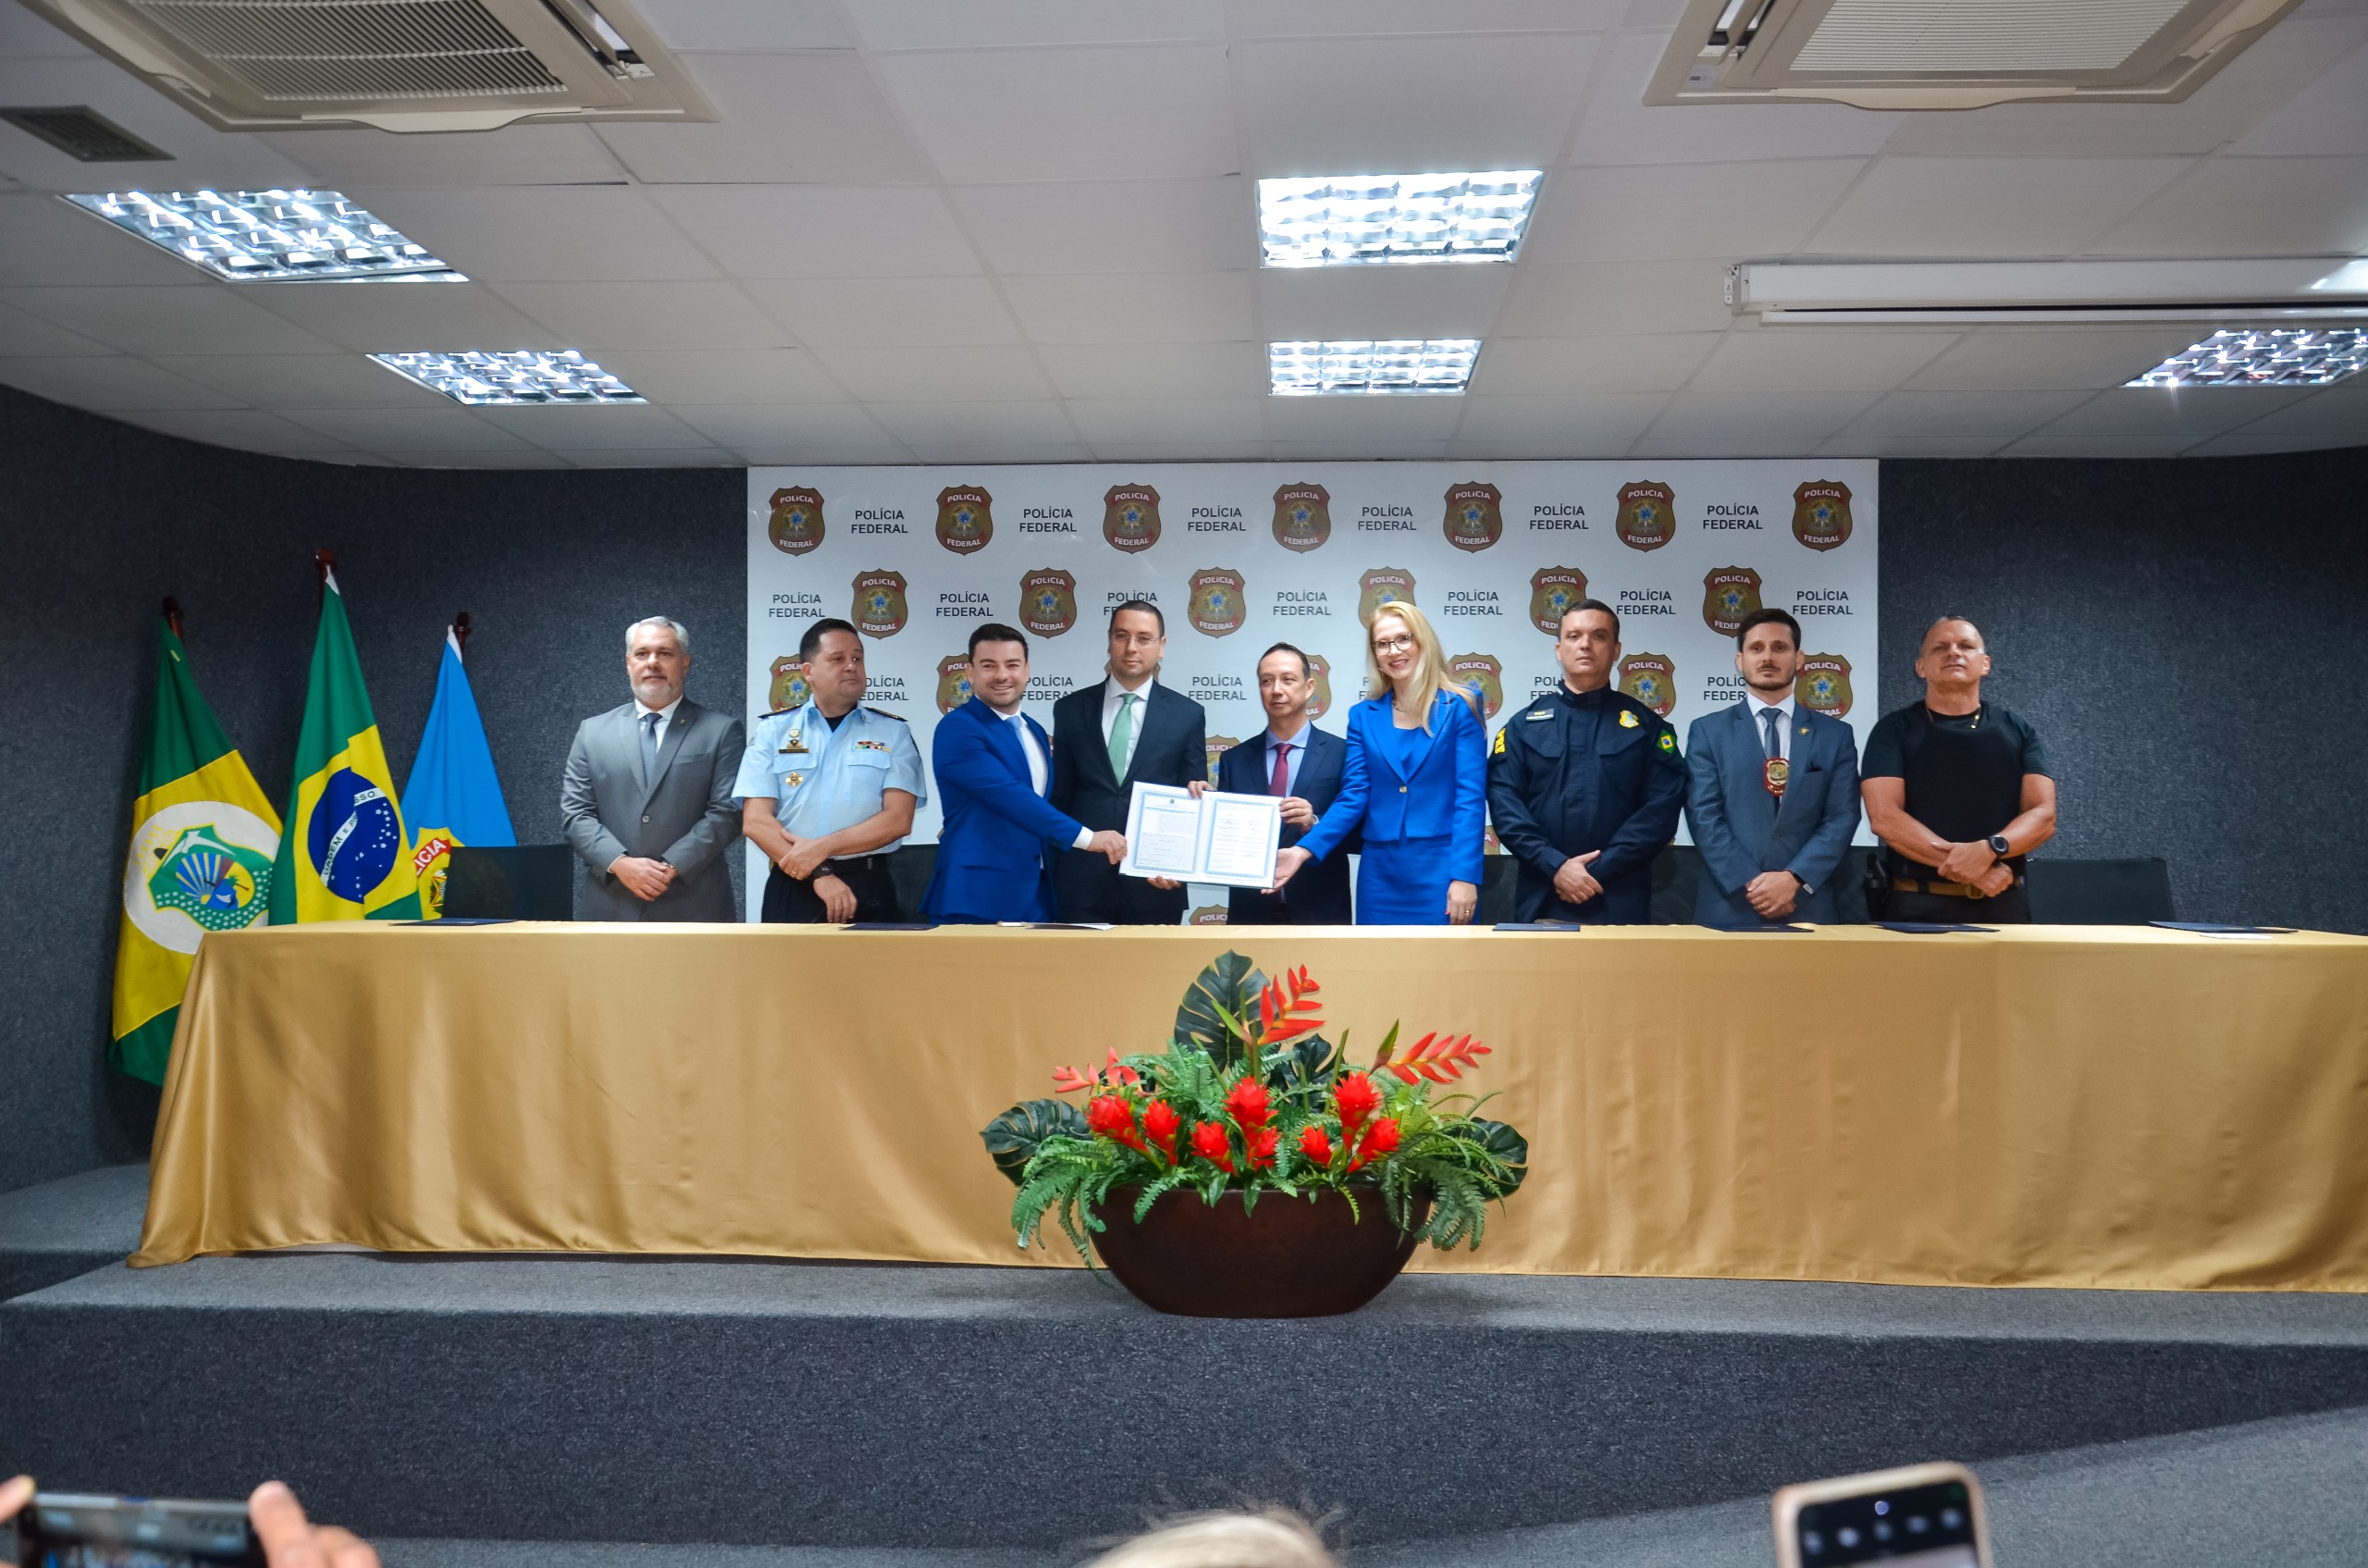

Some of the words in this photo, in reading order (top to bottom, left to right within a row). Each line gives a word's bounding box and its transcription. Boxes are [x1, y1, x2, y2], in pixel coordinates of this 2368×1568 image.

[855, 507, 905, 521] POLÍCIA
[1023, 505, 1073, 519] POLÍCIA
[1191, 504, 1242, 518] POLÍCIA
[1362, 503, 1413, 517] POLÍCIA
[1534, 502, 1585, 516] POLÍCIA
[1707, 502, 1759, 516] POLÍCIA
[851, 524, 908, 534] FEDERAL
[1019, 522, 1078, 533] FEDERAL
[1187, 521, 1247, 532] FEDERAL
[1358, 520, 1417, 531] FEDERAL
[1529, 519, 1589, 530] FEDERAL
[1702, 519, 1763, 530] FEDERAL
[779, 538, 814, 549] FEDERAL
[946, 537, 981, 548] FEDERAL
[1114, 537, 1150, 547] FEDERAL
[1283, 536, 1319, 546] FEDERAL
[1454, 535, 1491, 545] FEDERAL
[1627, 535, 1664, 545] FEDERAL
[1804, 534, 1841, 544] FEDERAL
[772, 591, 822, 604] POLÍCIA
[940, 590, 990, 603] POLÍCIA
[1106, 589, 1158, 602] POLÍCIA
[1276, 589, 1327, 602] POLÍCIA
[1448, 588, 1499, 602] POLÍCIA
[1620, 587, 1672, 601] POLÍCIA
[1796, 587, 1849, 601] POLÍCIA
[769, 608, 826, 618] FEDERAL
[935, 606, 994, 617] FEDERAL
[1273, 605, 1332, 616] FEDERAL
[1444, 605, 1503, 616] FEDERAL
[1616, 604, 1677, 615] FEDERAL
[1792, 604, 1854, 615] FEDERAL
[861, 622, 896, 632] FEDERAL
[1030, 621, 1066, 631] FEDERAL
[1198, 621, 1235, 631] FEDERAL
[1714, 619, 1740, 630] FEDER
[865, 673, 906, 687] OLÍCIA
[1192, 673, 1243, 686] POLÍCIA
[1707, 673, 1747, 687] POLÍC
[858, 690, 909, 701] EDERAL
[1188, 690, 1247, 701] FEDERAL
[1703, 690, 1747, 701] FEDER
